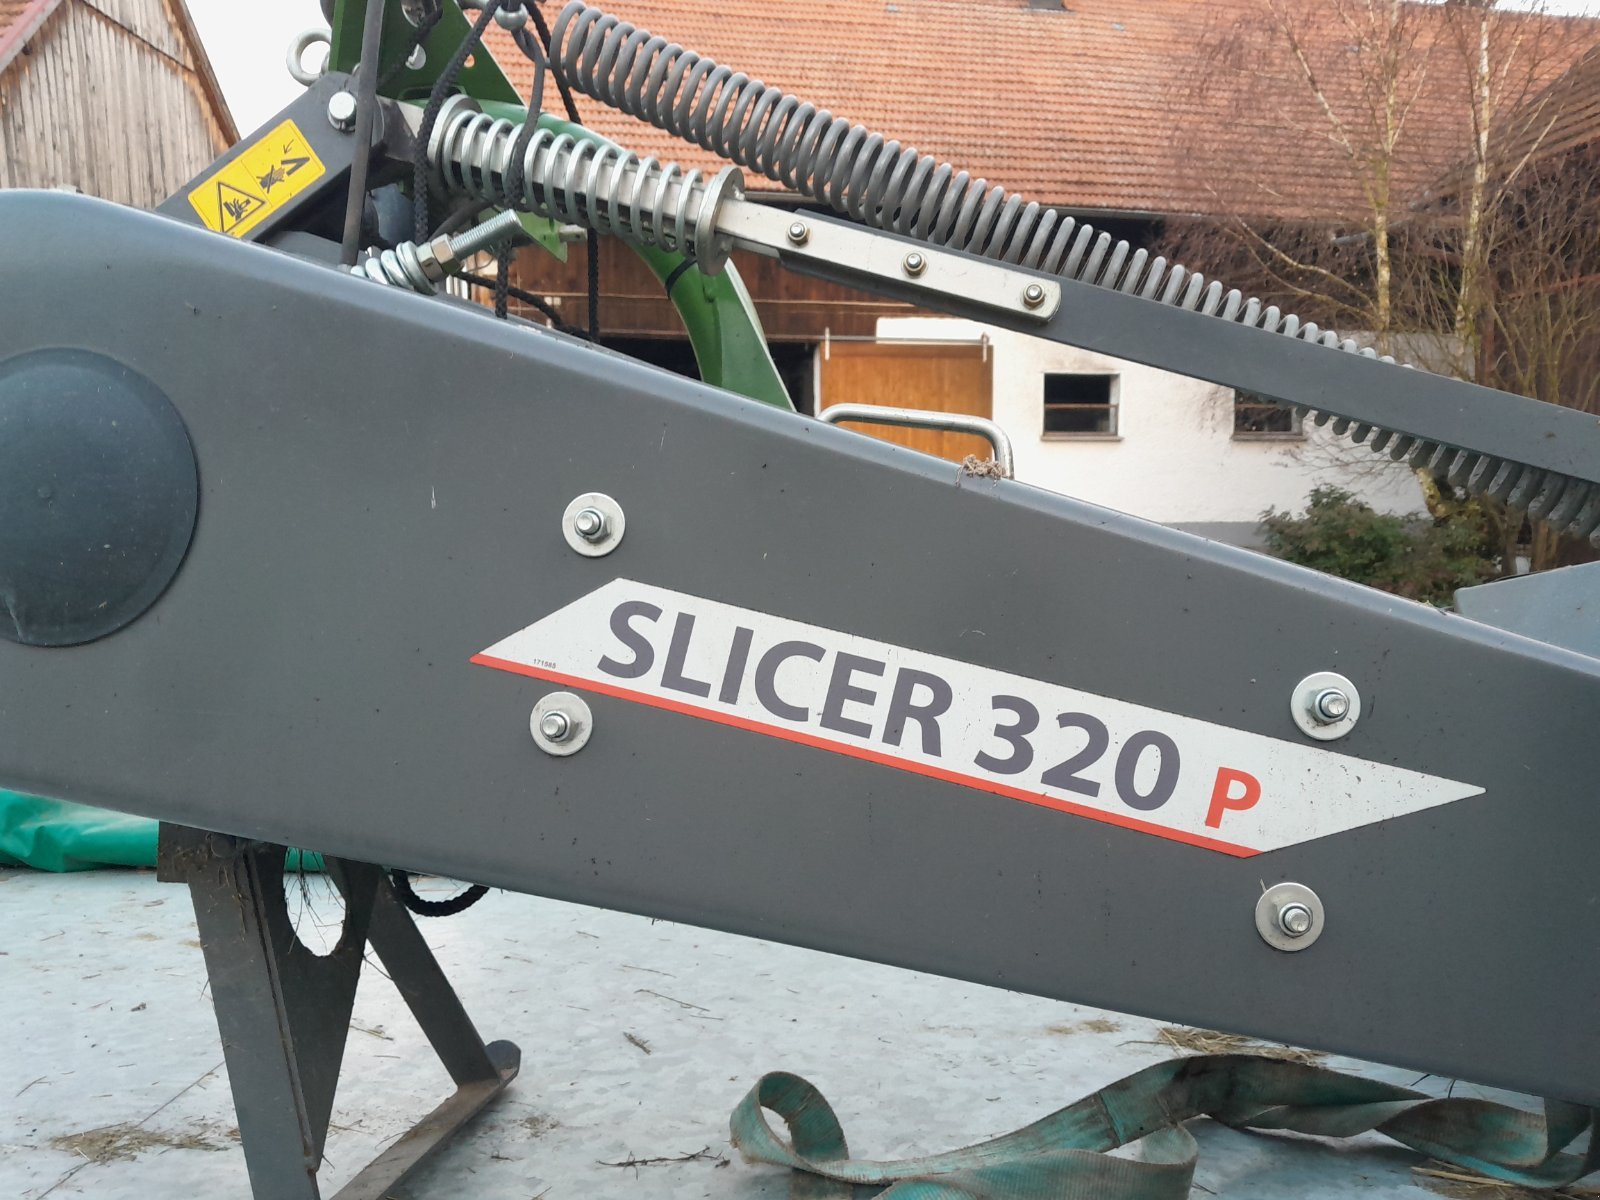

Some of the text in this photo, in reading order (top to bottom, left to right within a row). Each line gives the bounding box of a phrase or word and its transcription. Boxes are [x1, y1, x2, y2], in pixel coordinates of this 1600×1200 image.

[597, 600, 1262, 829] SLICER 320 P
